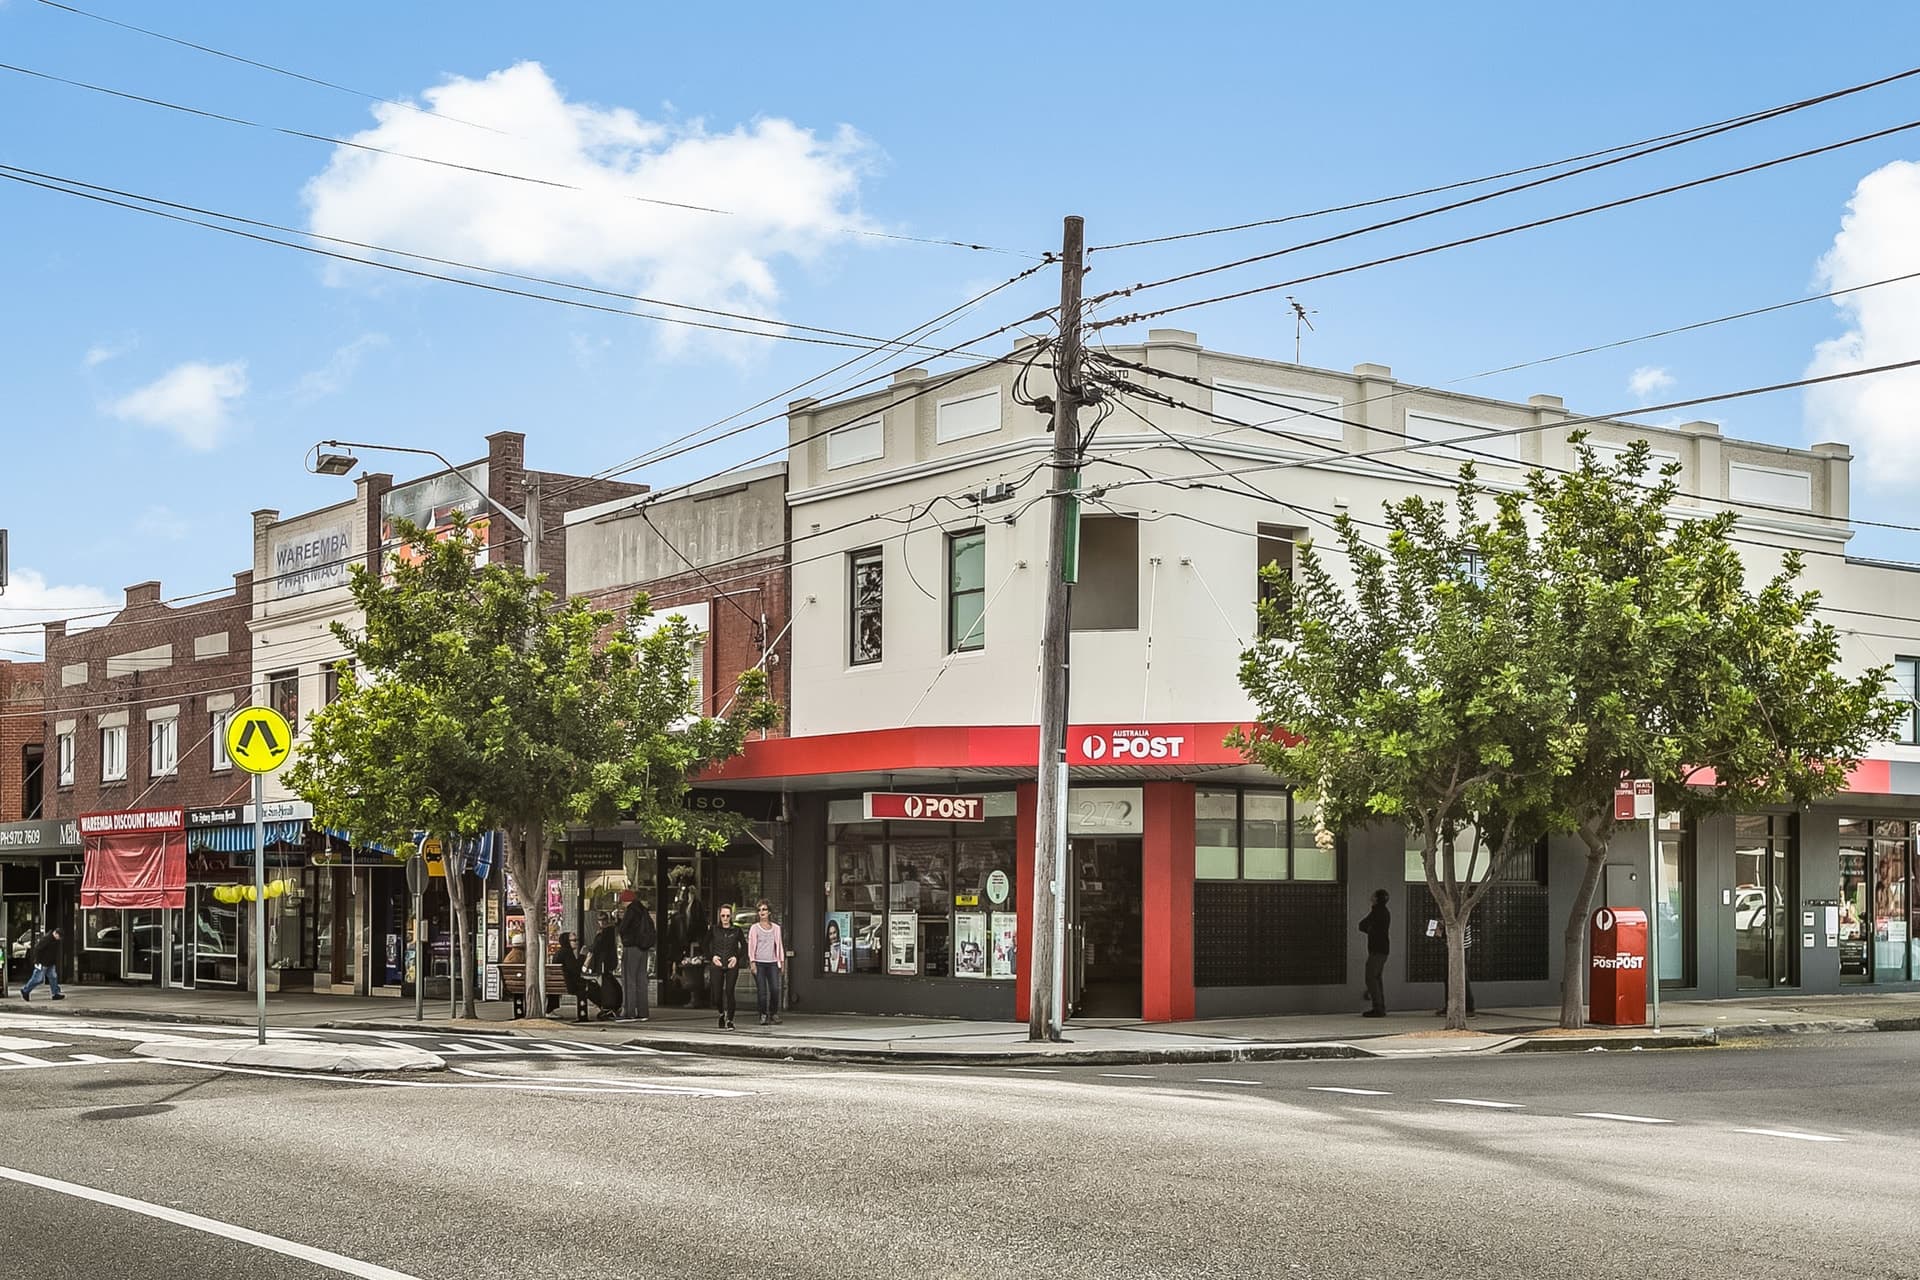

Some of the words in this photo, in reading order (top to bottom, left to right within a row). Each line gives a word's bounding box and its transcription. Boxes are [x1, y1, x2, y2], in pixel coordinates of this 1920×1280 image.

[276, 534, 348, 568] WAREEMBA
[1112, 737, 1184, 758] POST
[926, 799, 978, 818] POST
[1079, 801, 1132, 827] 272
[81, 815, 113, 832] WAREEMBA
[113, 813, 145, 830] DISCOUNT
[146, 810, 181, 828] PHARMACY
[24, 829, 40, 844] 7609
[1593, 959, 1616, 969] POST
[1616, 956, 1644, 969] POST
